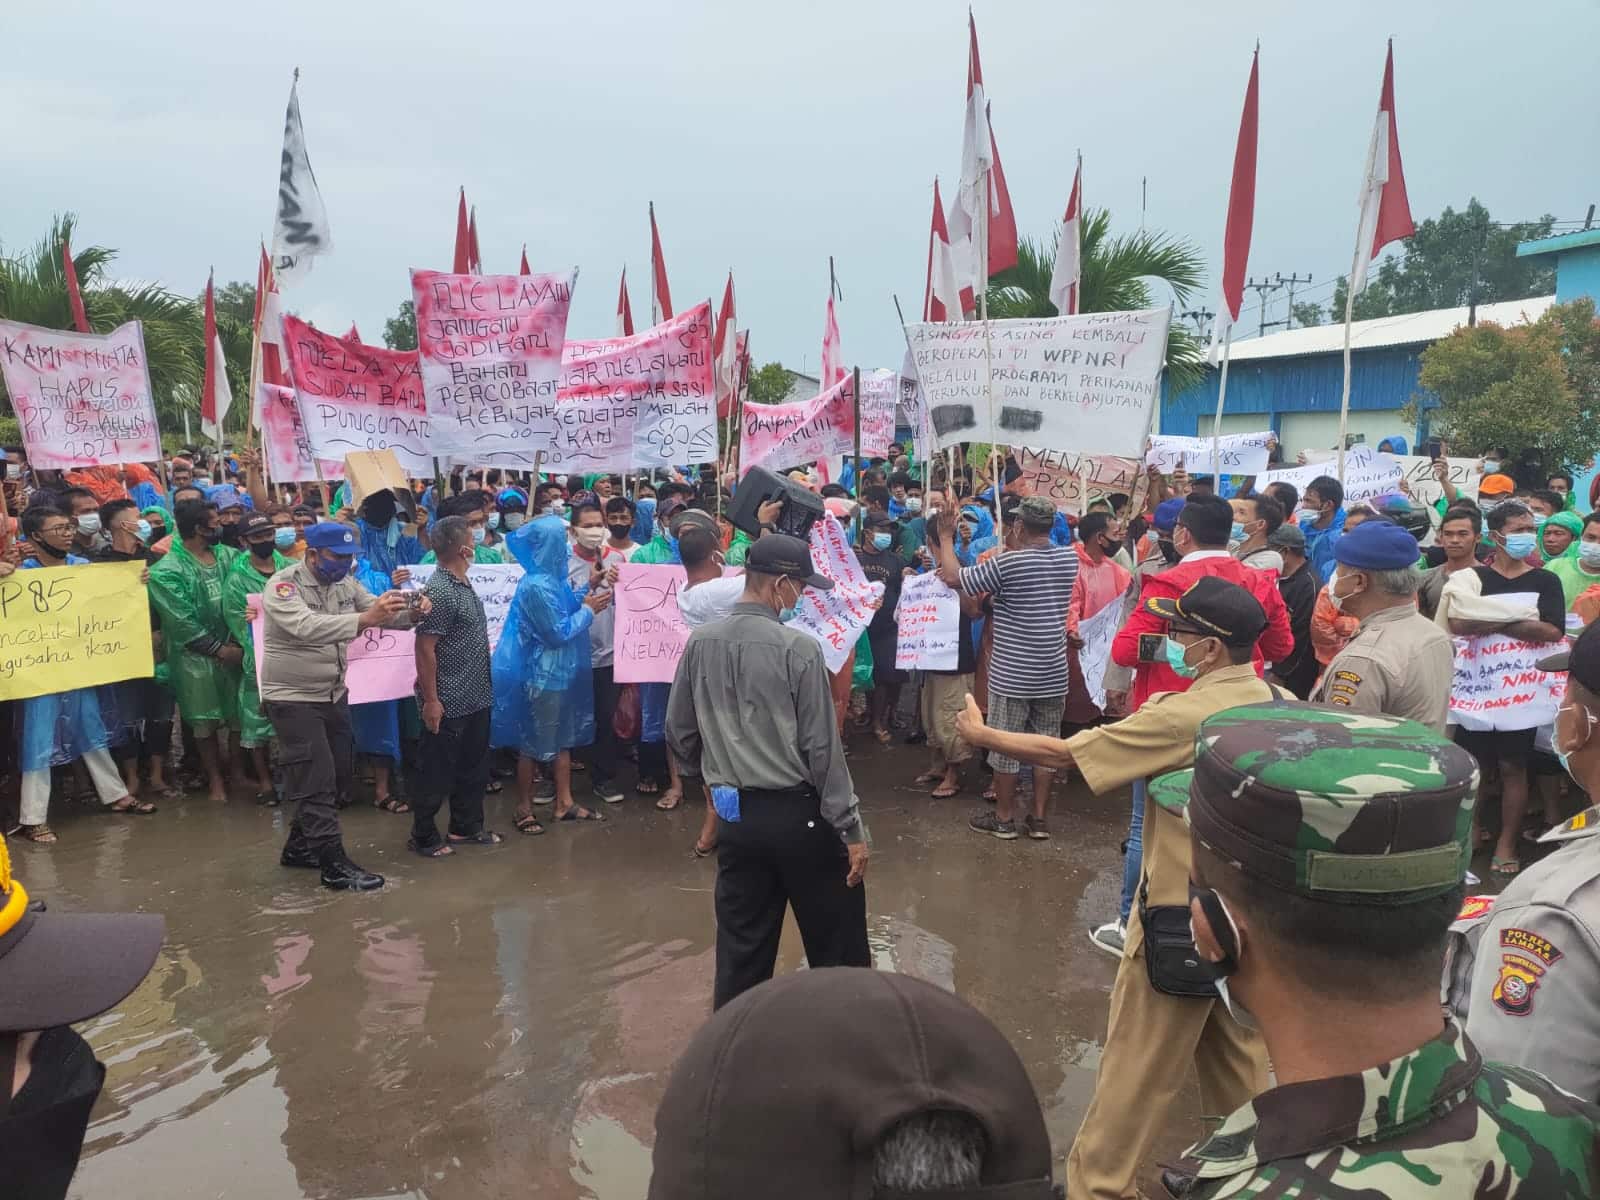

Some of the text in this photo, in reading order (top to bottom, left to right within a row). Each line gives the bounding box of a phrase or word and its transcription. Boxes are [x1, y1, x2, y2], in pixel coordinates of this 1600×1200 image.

[1072, 328, 1146, 345] KEMBALI
[1043, 348, 1126, 369] WPPNRI
[38, 376, 119, 401] HAPUS
[303, 371, 367, 403] SUDAH
[991, 367, 1068, 387] PROGRAM
[1079, 373, 1152, 395] PERIKANAN
[930, 384, 1142, 410] TERUKUR DAN BERKELANJUTAN
[23, 406, 52, 439] PP
[64, 410, 88, 435] 85
[64, 438, 121, 459] 2021
[1507, 930, 1553, 951] POLRES
